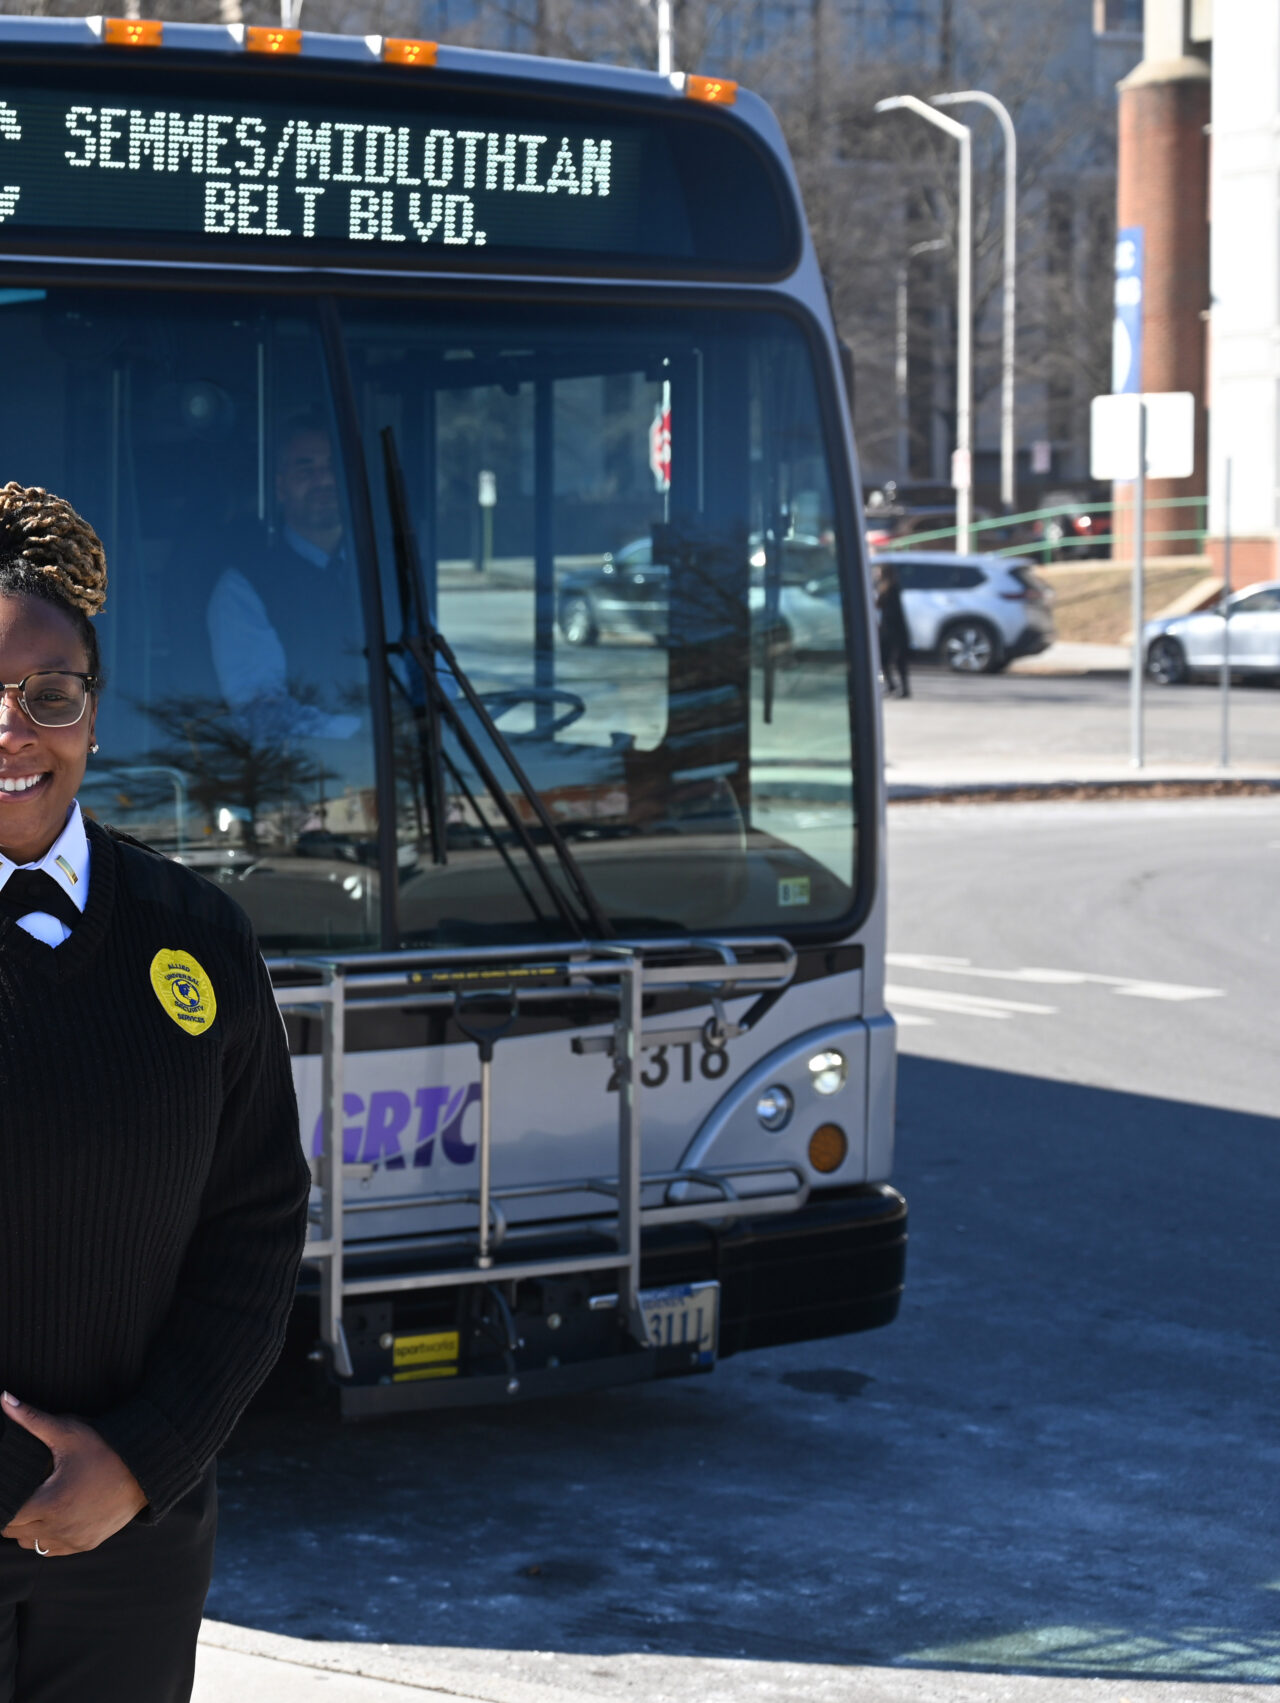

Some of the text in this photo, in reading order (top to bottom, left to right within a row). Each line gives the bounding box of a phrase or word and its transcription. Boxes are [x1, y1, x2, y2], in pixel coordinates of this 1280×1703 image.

[64, 106, 612, 196] SEMMES/MIDLOTHIAN
[204, 182, 487, 245] BELT BLVD.
[168, 963, 190, 972] ALLIED
[164, 973, 200, 986] UNIVERSAL
[175, 1000, 204, 1013] SECURITY
[177, 1013, 206, 1024] SERVICES
[312, 1081, 483, 1172] GRTC
